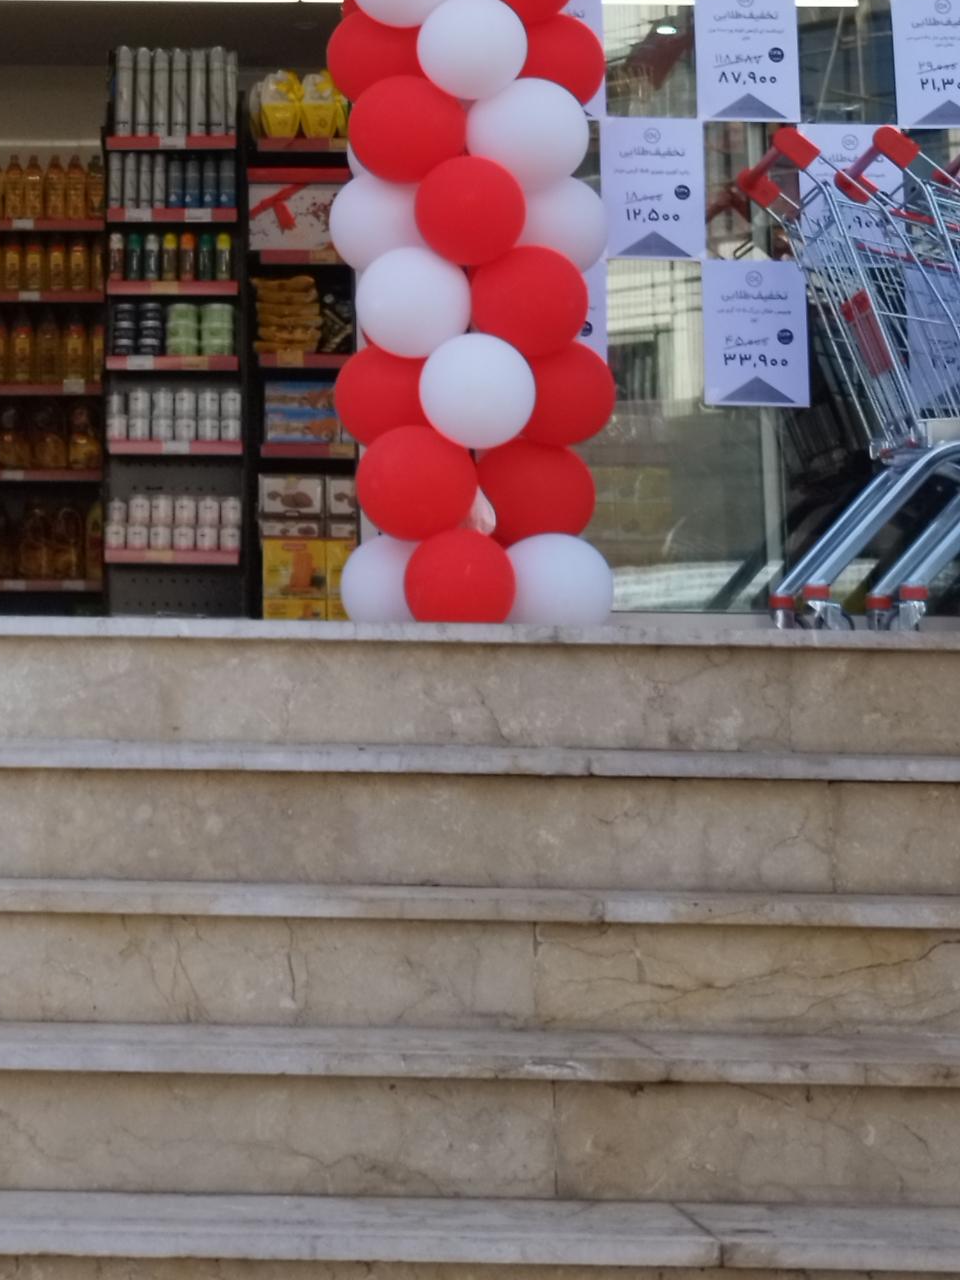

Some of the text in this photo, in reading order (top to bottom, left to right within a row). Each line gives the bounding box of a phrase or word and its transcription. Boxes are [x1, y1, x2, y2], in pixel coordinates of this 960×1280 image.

[718, 71, 777, 85] ۸۷,۹۰۰
[626, 208, 680, 223] ۱۲,۵۰۰
[723, 354, 788, 368] ۳۳,۹۰۰
